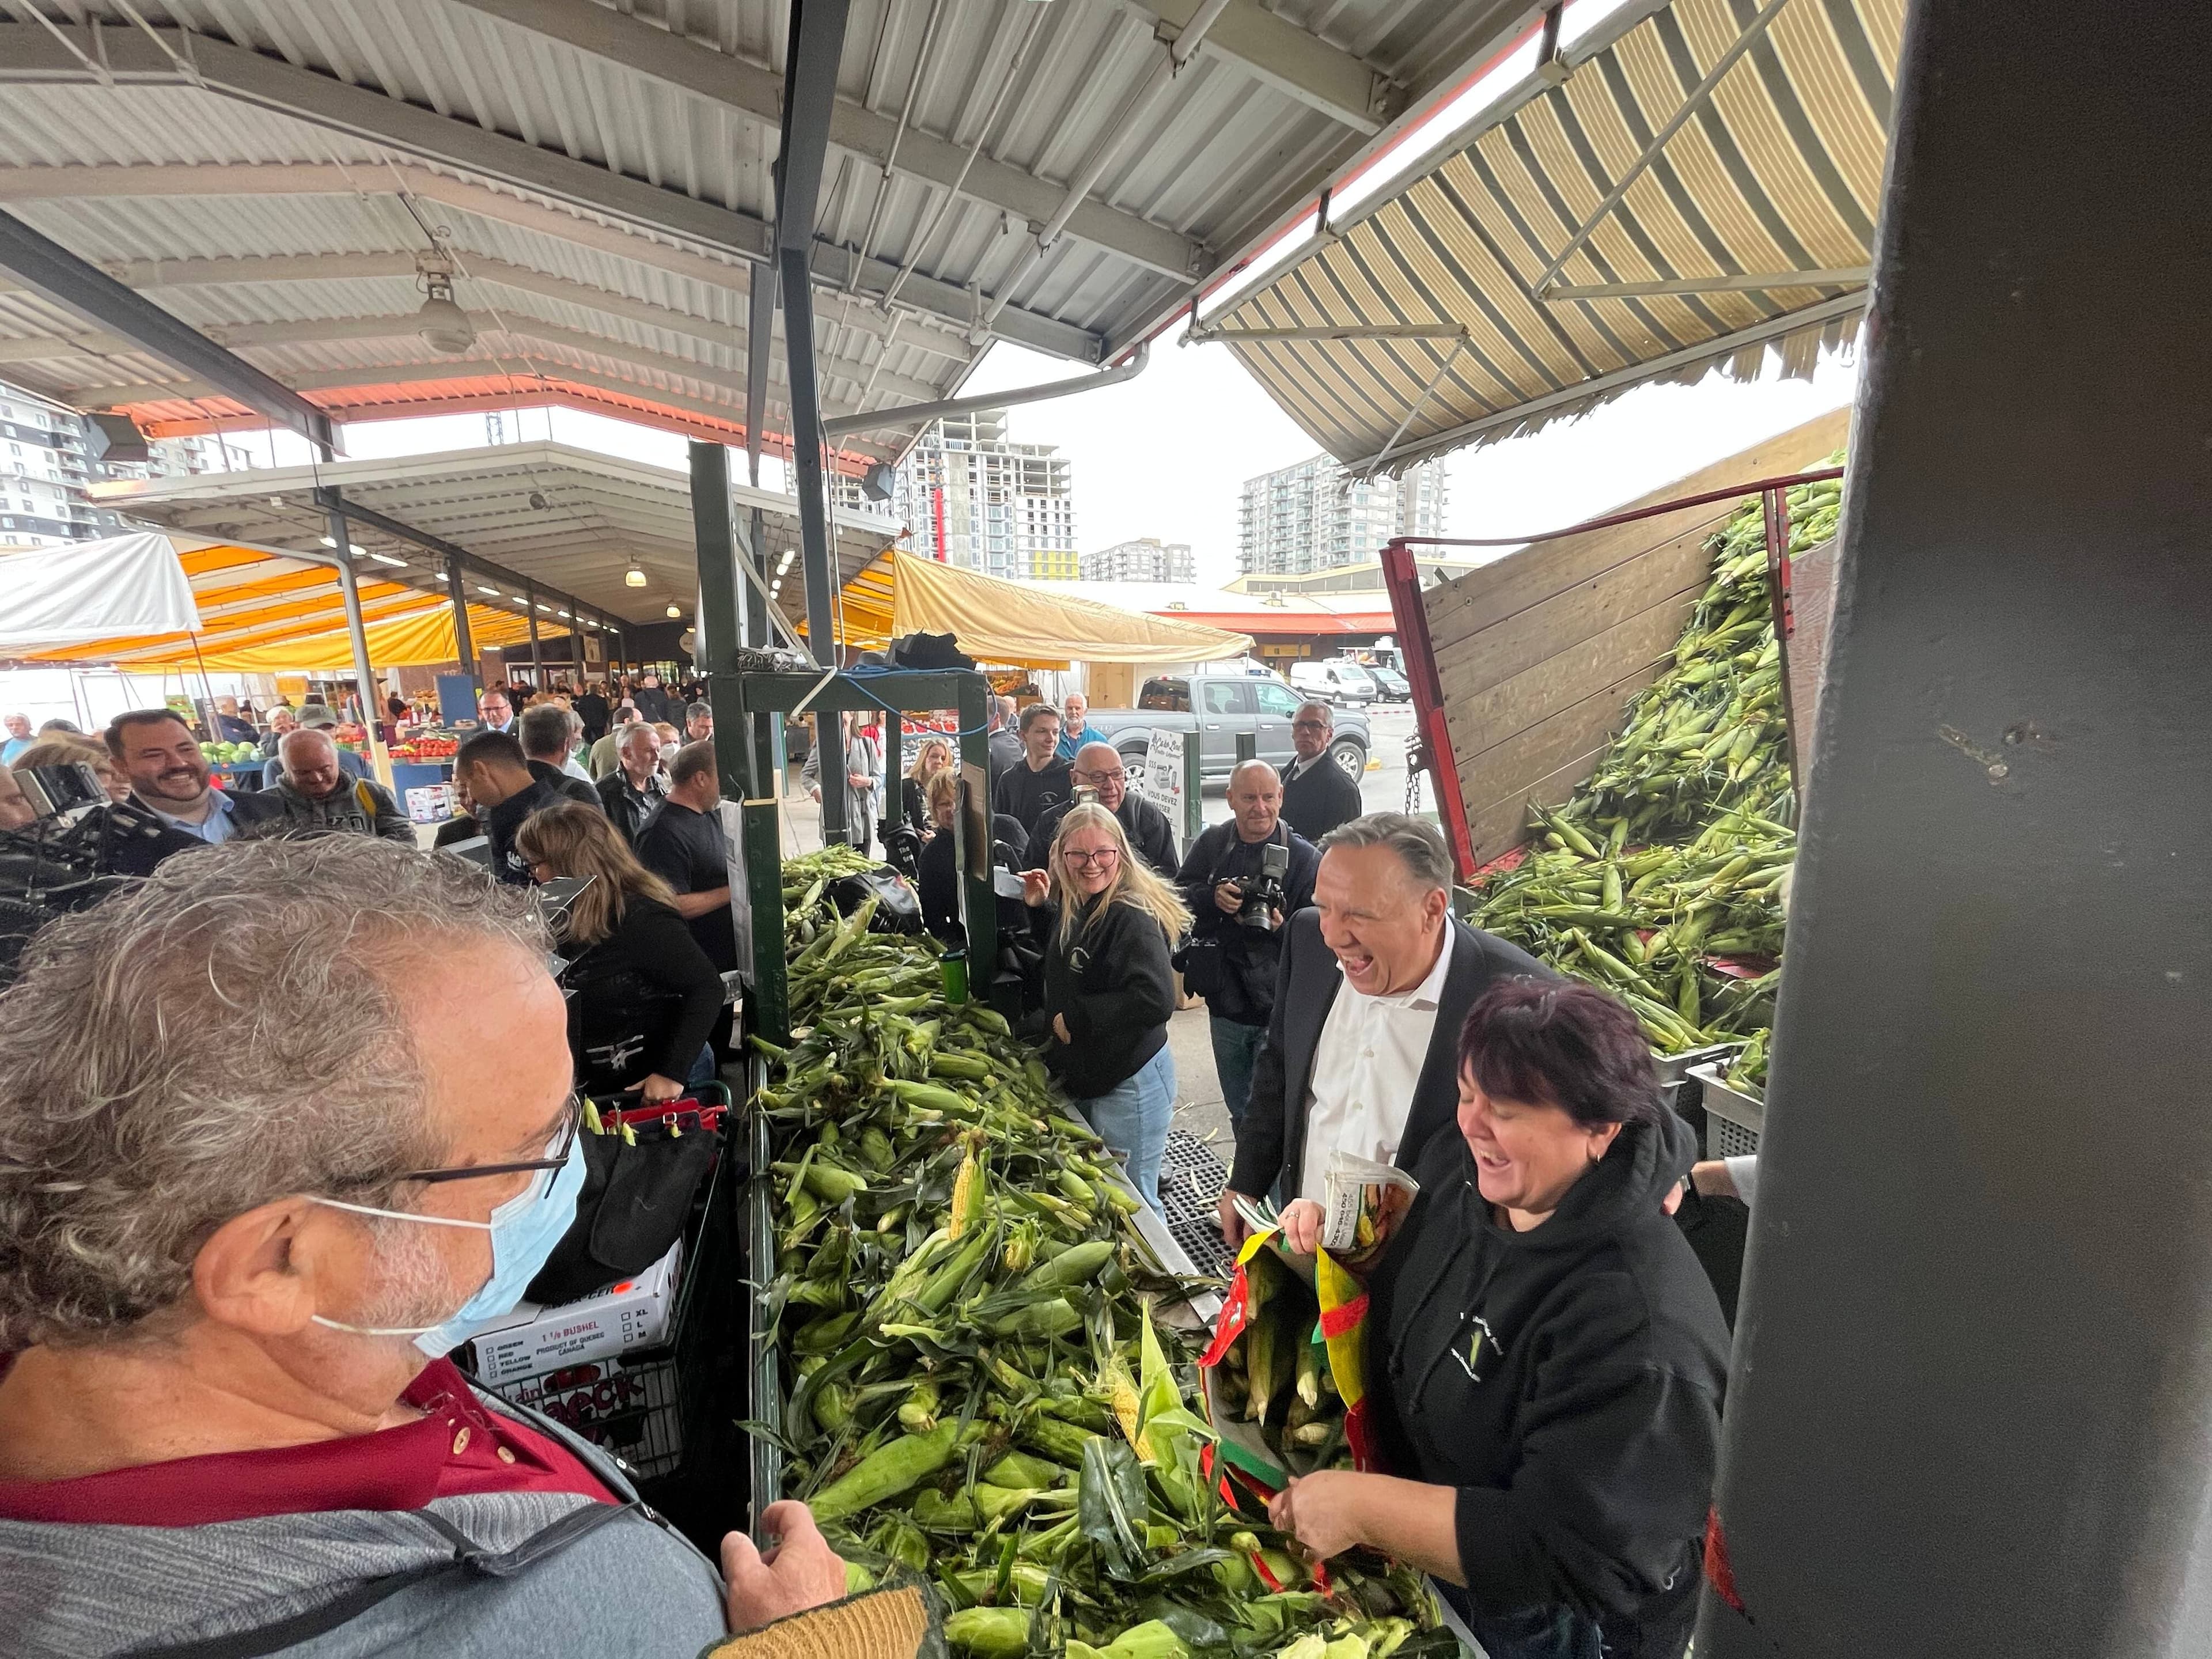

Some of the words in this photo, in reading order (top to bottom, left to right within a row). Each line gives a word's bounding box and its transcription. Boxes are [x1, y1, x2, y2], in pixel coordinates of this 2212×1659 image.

[1147, 789, 1160, 800] VOUS
[1161, 794, 1177, 806] DEVEZ
[635, 1309, 648, 1317] XL
[563, 1321, 599, 1336] BUSHEL
[497, 1340, 524, 1351] GREEN
[536, 1342, 567, 1355] PRODUCT
[569, 1339, 578, 1347] OF
[558, 1344, 585, 1356] CANADA
[498, 1351, 514, 1360] RED
[499, 1355, 531, 1367] YELLOW
[501, 1363, 533, 1375] ORANGE
